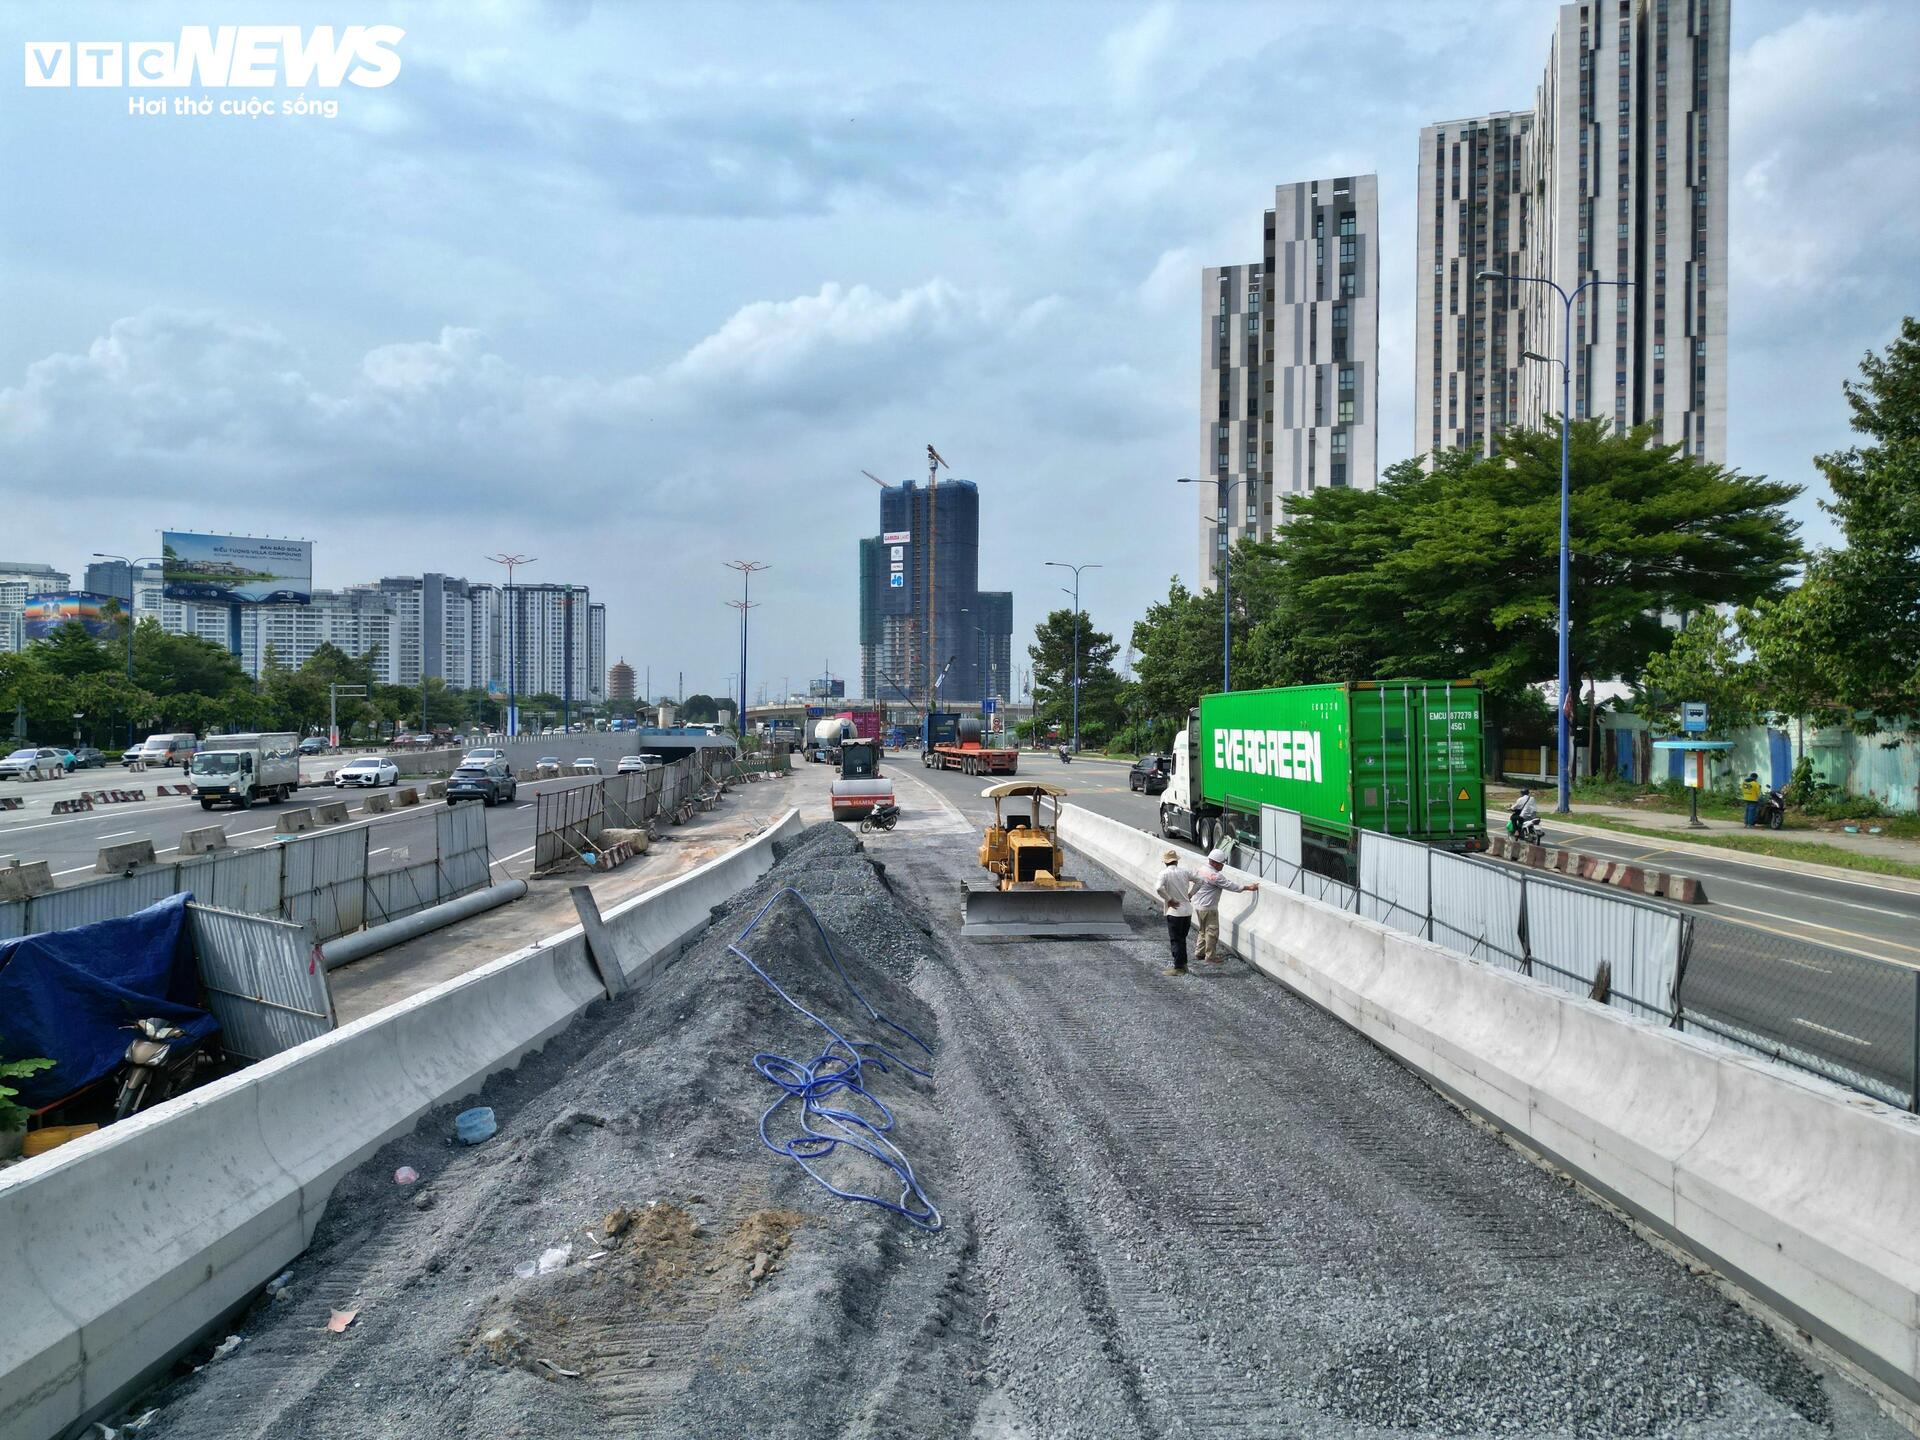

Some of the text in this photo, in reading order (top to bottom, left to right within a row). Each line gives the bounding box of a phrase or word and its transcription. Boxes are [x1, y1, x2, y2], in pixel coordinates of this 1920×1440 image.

[1429, 712, 1447, 720] EMCU
[1450, 722, 1466, 731] 45G1
[1214, 728, 1322, 784] EVERGREEN
